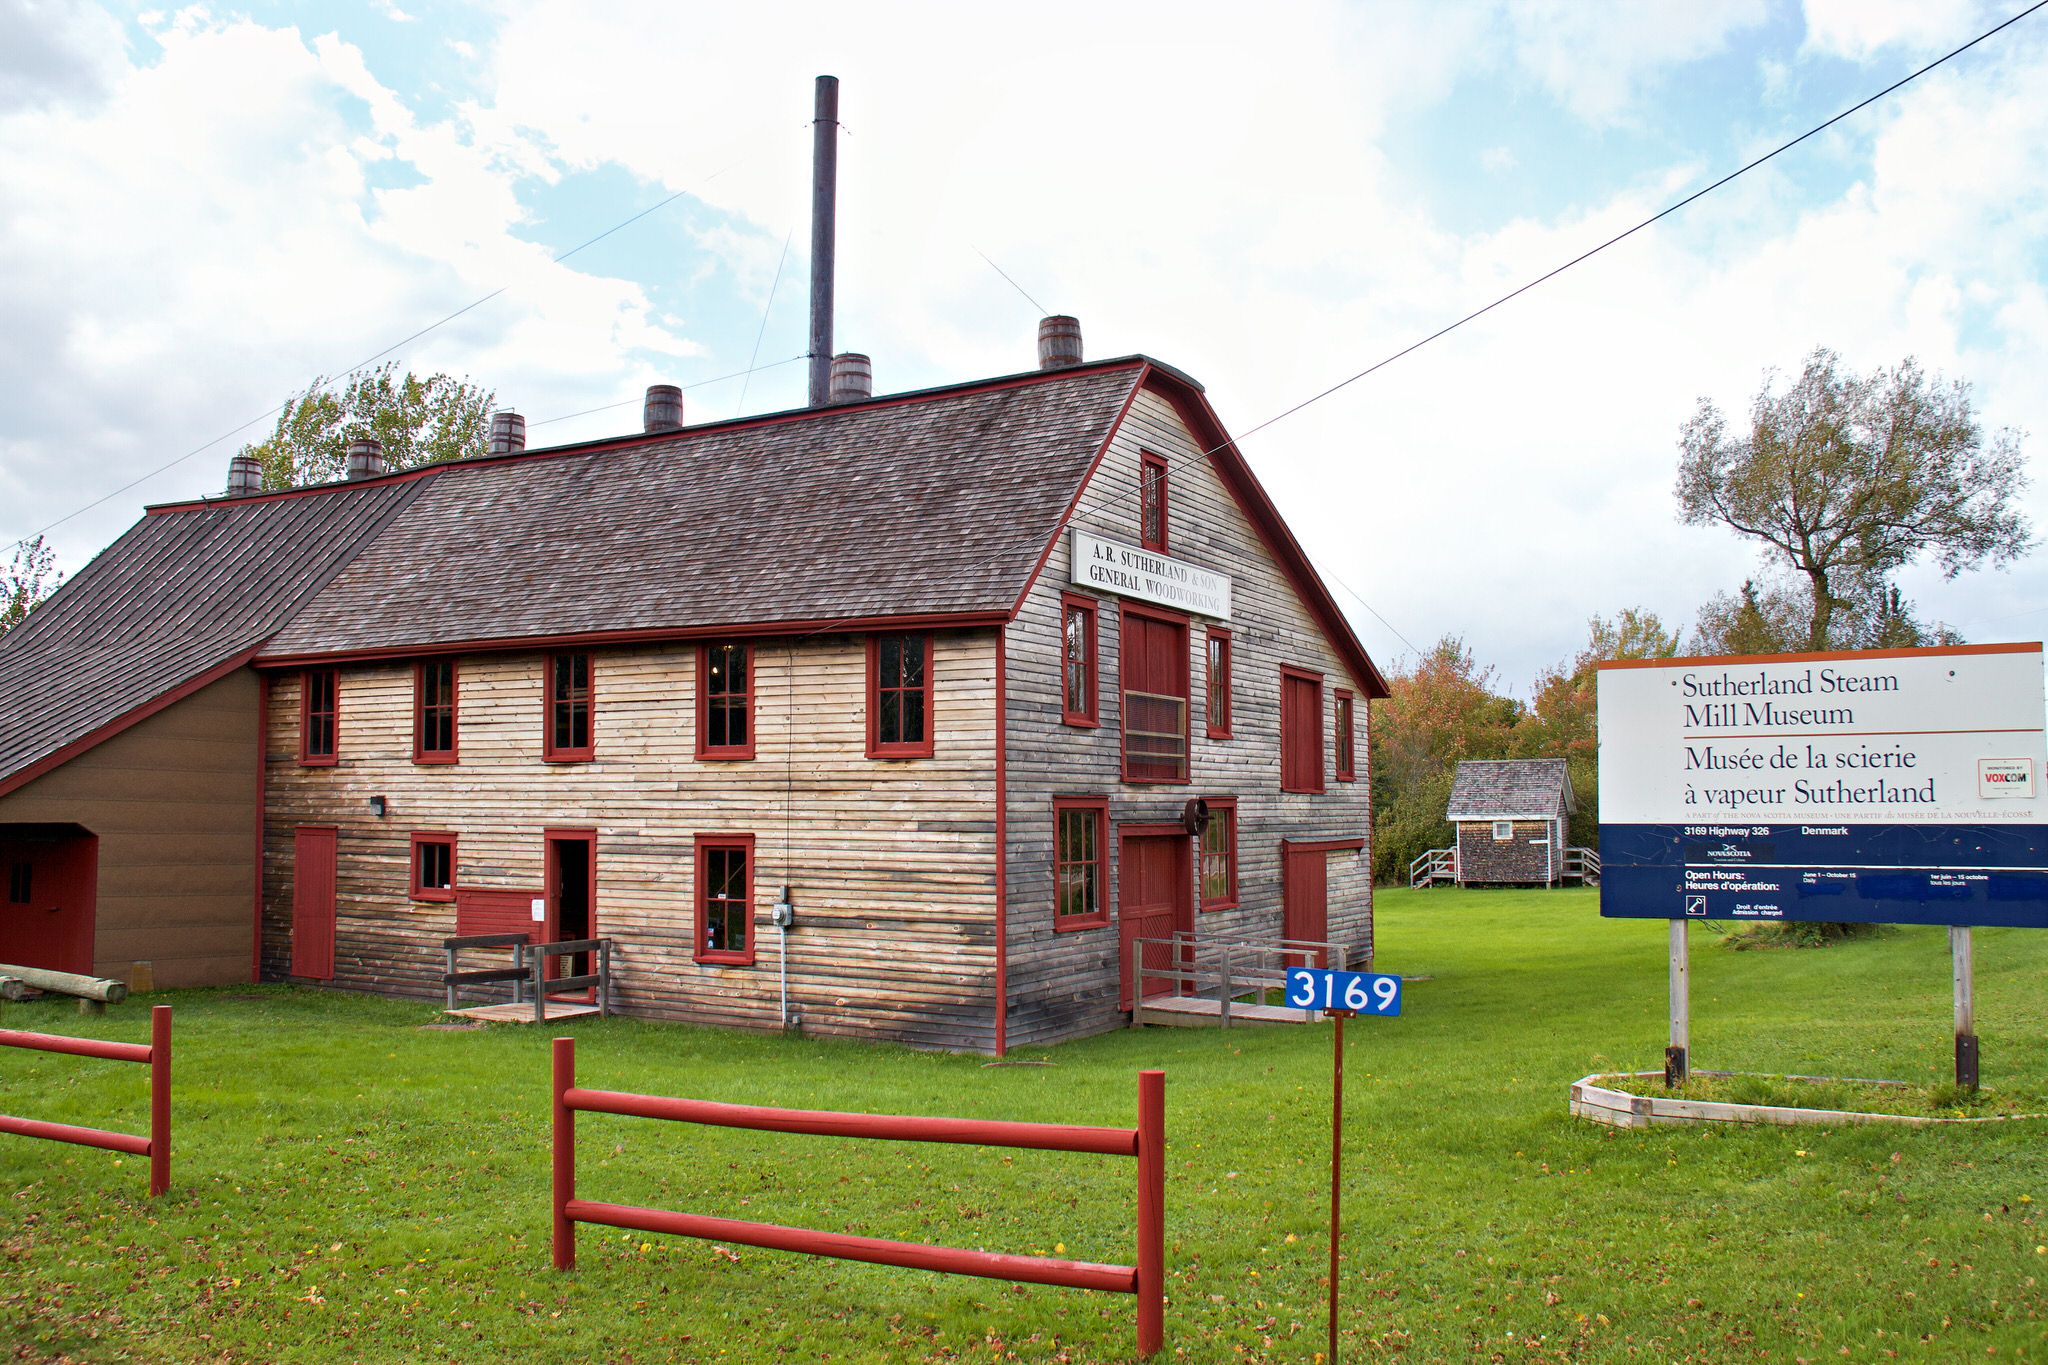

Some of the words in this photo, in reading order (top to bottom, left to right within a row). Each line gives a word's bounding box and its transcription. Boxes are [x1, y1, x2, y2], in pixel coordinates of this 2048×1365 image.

[1093, 543, 1104, 560] A.
[1106, 546, 1116, 563] R.
[1121, 550, 1188, 584] SUTHERLAND
[1191, 573, 1199, 585] &
[1200, 575, 1217, 591] SON
[1090, 564, 1141, 591] GENERAL
[1145, 578, 1220, 612] WOODWORKING
[1683, 670, 1812, 697] Sutherland
[1820, 668, 1899, 693] Steam
[1683, 704, 1738, 727] Mill
[1743, 701, 1854, 726] Museum
[1684, 746, 1764, 770] Musée
[1770, 745, 1798, 768] de
[1806, 745, 1828, 768] la
[1835, 744, 1917, 768] scierie
[1985, 773, 2027, 783] VOXCOM
[1685, 783, 1697, 804] à
[1704, 788, 1786, 809] vapeur
[1794, 778, 1936, 804] Sutherland
[1684, 826, 1707, 836] 3169
[1708, 826, 1750, 838] Highway
[1751, 826, 1770, 836] 326
[1801, 826, 1848, 836] Denmark
[1685, 871, 1711, 881] Open
[1713, 871, 1745, 880] Hours:
[1685, 881, 1719, 890] Heures
[1720, 881, 1780, 892] d'opération:
[1292, 971, 1397, 1011] 3169
